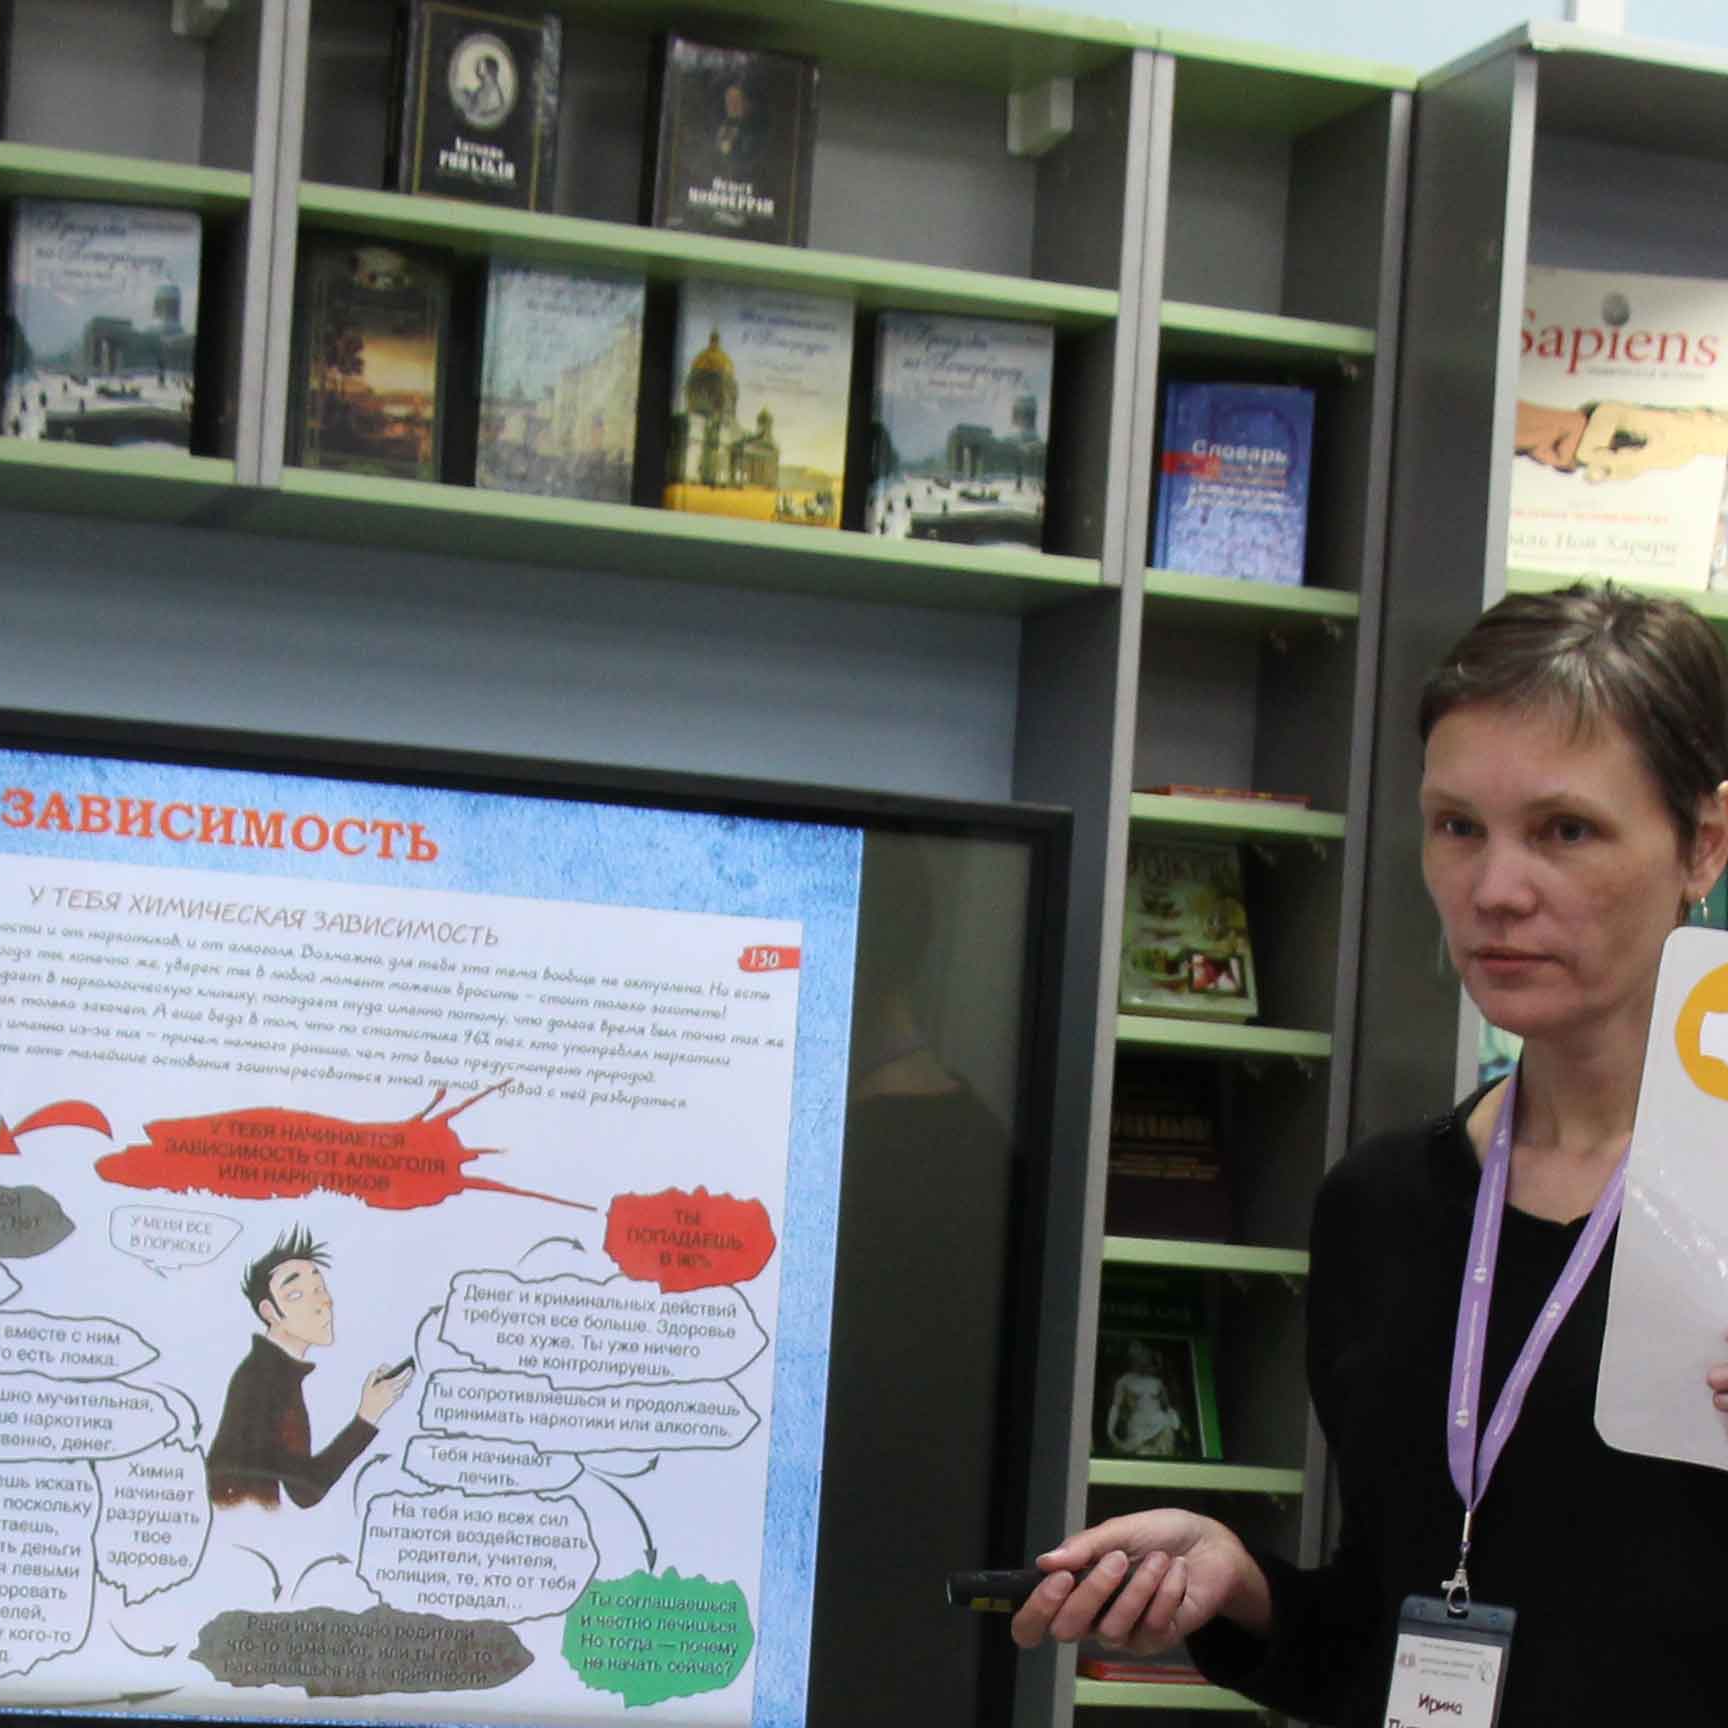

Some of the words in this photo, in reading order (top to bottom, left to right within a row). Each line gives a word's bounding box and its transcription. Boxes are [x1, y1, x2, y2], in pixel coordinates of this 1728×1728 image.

[1191, 438, 1289, 466] Словарь
[0, 787, 440, 864] ЗАВИСИМОСТЬ
[28, 884, 46, 906] У
[53, 885, 121, 913] ТЕБЯ
[128, 893, 307, 930] ХИМИЧЕСКАЯ
[314, 910, 499, 948] ЗАВИСИМОСТЬ
[748, 947, 780, 970] 130
[3, 1326, 67, 1342] вместе
[85, 1331, 122, 1345] ним
[16, 1348, 56, 1363] есть
[22, 1412, 114, 1431] наркотика
[35, 1477, 94, 1492] искать
[2, 1497, 93, 1514] поскольку
[20, 1542, 82, 1557] деньги
[11, 1563, 81, 1578] левыми
[8, 1628, 72, 1643] кого-то
[1418, 1693, 1463, 1716] Ирина
